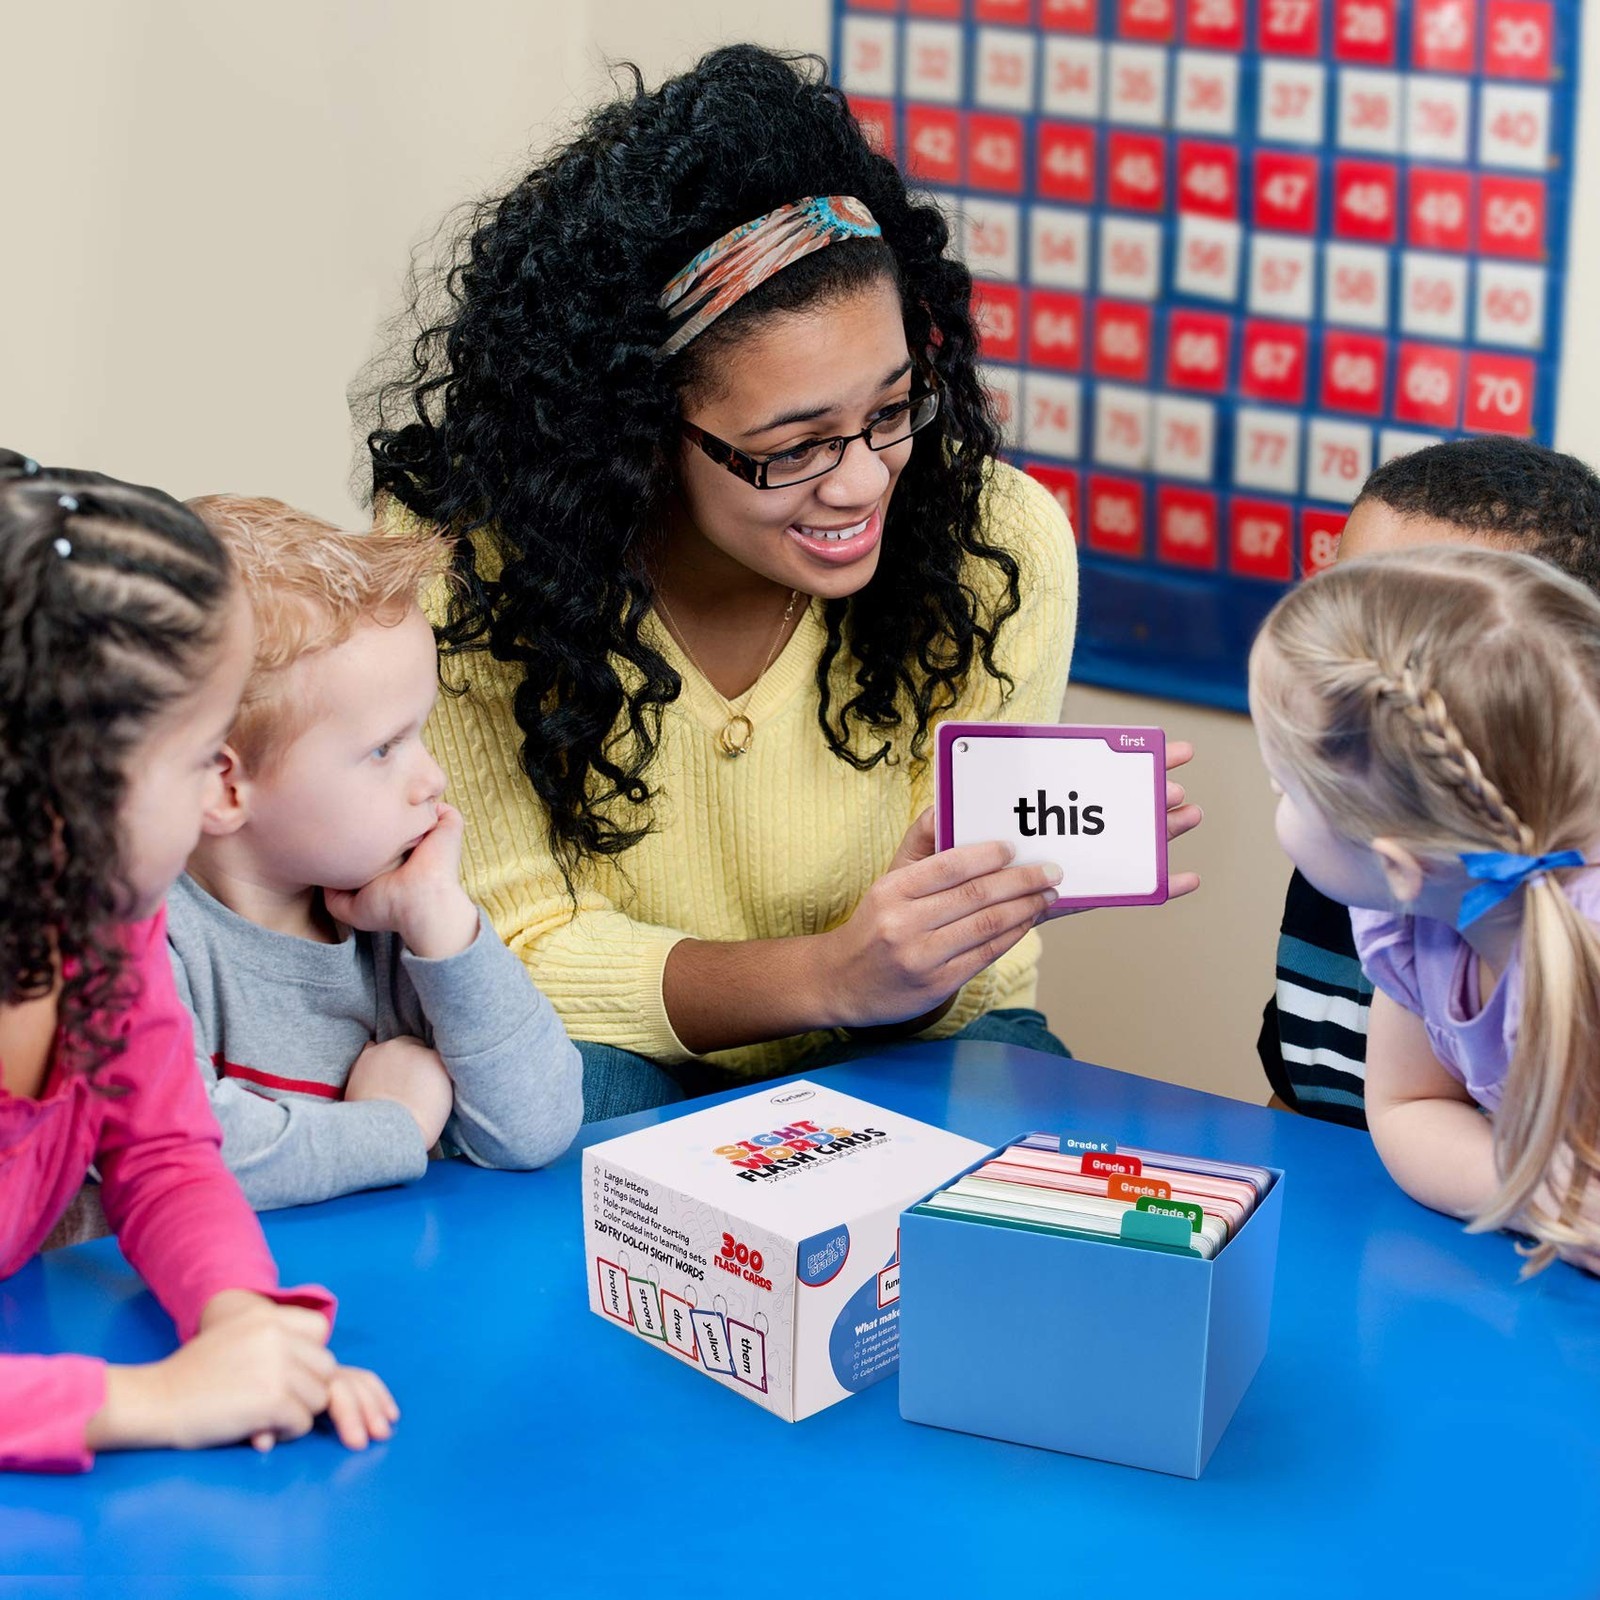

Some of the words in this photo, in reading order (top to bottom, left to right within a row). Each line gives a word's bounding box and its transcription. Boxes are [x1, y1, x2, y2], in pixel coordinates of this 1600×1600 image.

[1494, 18, 1542, 58] 30
[1490, 110, 1538, 148] 40
[1485, 198, 1535, 237] 50
[1484, 287, 1533, 325] 60
[1475, 373, 1524, 416] 70
[1249, 431, 1288, 466] 77
[1320, 442, 1360, 481] 78
[1238, 517, 1283, 559] 87
[1119, 734, 1146, 747] first
[1013, 789, 1106, 837] this
[713, 1119, 822, 1161] SIGHT
[731, 1126, 854, 1171] WORDS
[736, 1152, 817, 1183] FLASH
[813, 1127, 888, 1156] CARDS
[1067, 1139, 1099, 1151] Grade
[1100, 1142, 1109, 1151] K
[604, 1169, 624, 1187] Large
[624, 1178, 650, 1197] letters
[1092, 1159, 1125, 1174] Grade
[1129, 1165, 1135, 1174] 1
[603, 1182, 610, 1193] 5
[610, 1186, 629, 1202] rings
[629, 1193, 659, 1215] included
[1120, 1182, 1155, 1196] Grade
[1157, 1188, 1166, 1198] 2
[603, 1196, 650, 1226] Hole-punched
[650, 1217, 662, 1231] for
[662, 1224, 690, 1246] sorting
[1147, 1204, 1184, 1218] Grade
[1187, 1210, 1197, 1221] 3
[594, 1219, 608, 1233] 520
[608, 1226, 622, 1242] FRY
[622, 1232, 650, 1255] DOLCH
[650, 1245, 675, 1268] SIGHT
[675, 1257, 705, 1281] WORDS
[602, 1209, 621, 1224] Color
[621, 1216, 644, 1235] coded
[643, 1226, 659, 1243] into
[659, 1232, 688, 1258] learning
[688, 1250, 708, 1266] sets
[720, 1231, 765, 1273] 300
[608, 1269, 620, 1314] brother
[713, 1254, 742, 1278] FLASH
[742, 1268, 773, 1291] CARDS
[638, 1288, 654, 1330] strong
[673, 1308, 684, 1342] draw
[854, 1318, 878, 1336] What
[702, 1321, 721, 1363] yellow
[740, 1337, 753, 1374] them
